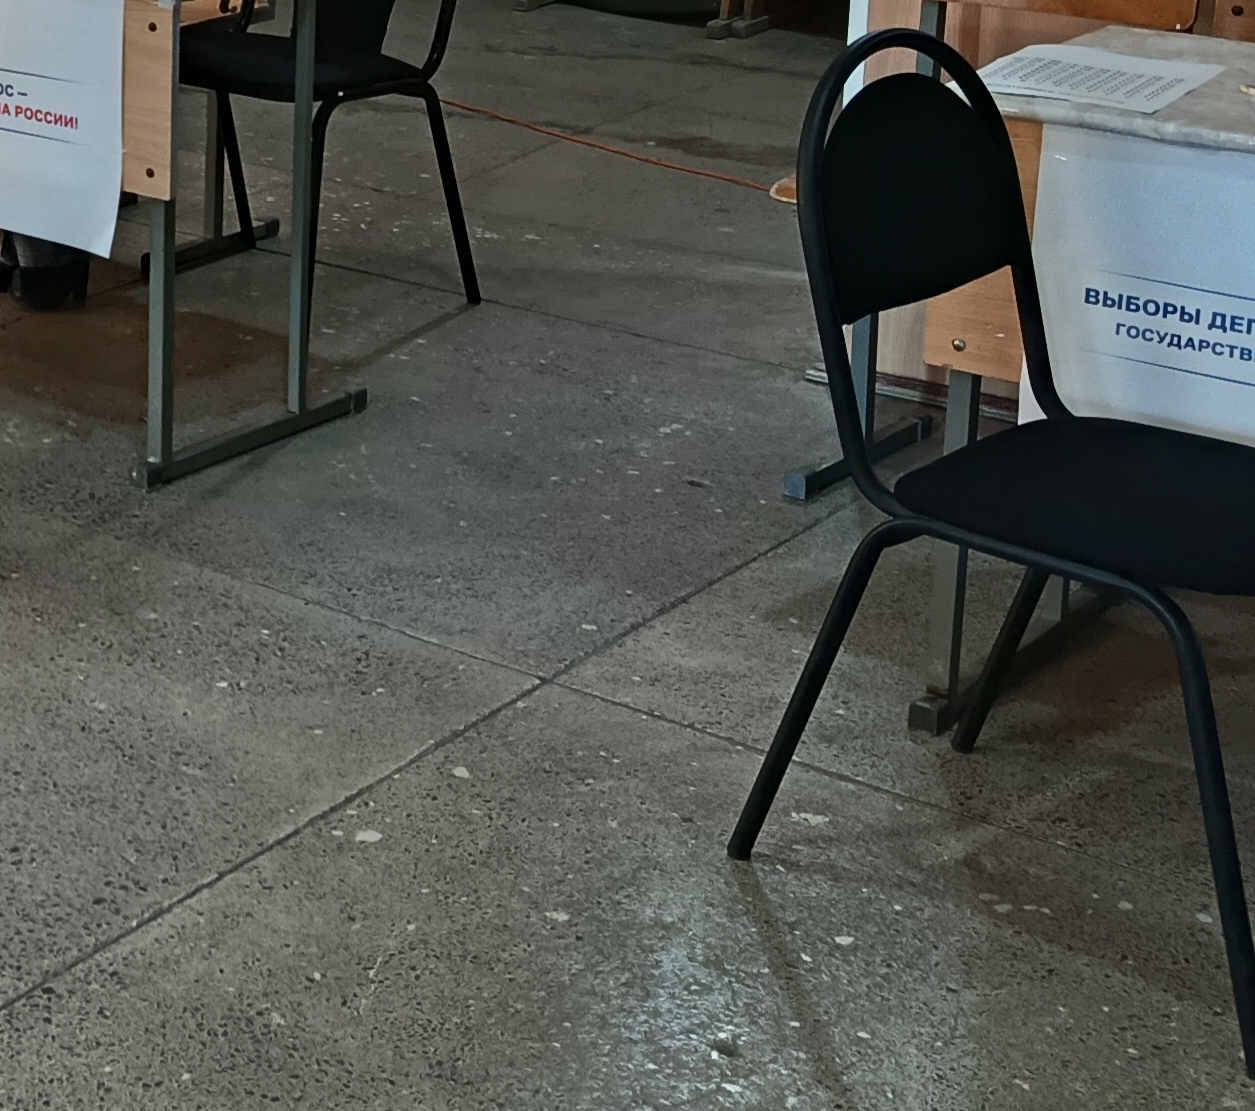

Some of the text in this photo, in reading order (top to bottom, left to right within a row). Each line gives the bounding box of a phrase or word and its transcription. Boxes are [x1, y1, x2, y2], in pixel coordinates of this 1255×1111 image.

[14, 105, 79, 130] РОССИИ!
[1084, 287, 1201, 326] ВЫБОРЫ
[1115, 322, 1255, 363] ГОСУДАРСТВ
